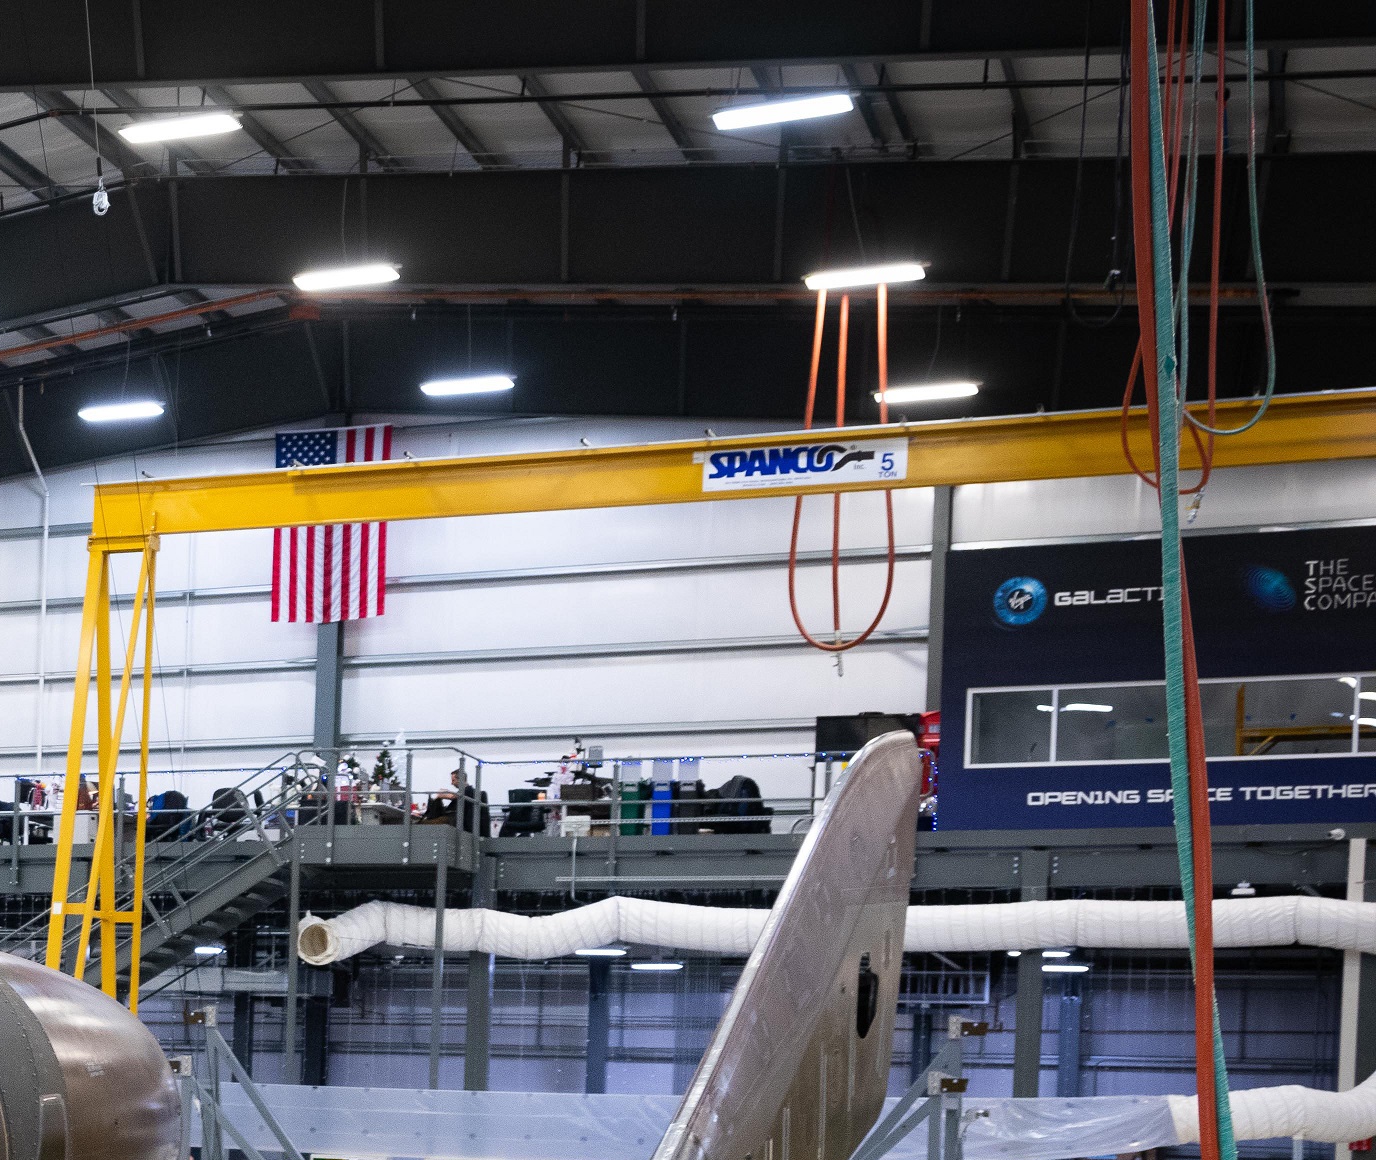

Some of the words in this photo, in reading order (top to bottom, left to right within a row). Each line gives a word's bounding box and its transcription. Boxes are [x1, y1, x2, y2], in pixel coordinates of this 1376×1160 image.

[709, 445, 836, 479] SPANCO
[880, 452, 895, 471] 5
[1305, 558, 1349, 576] THE
[1304, 574, 1375, 594] SPACE
[1304, 591, 1376, 611] COMPA
[1026, 789, 1141, 806] OPENING
[1239, 783, 1376, 801] TOGETHER
